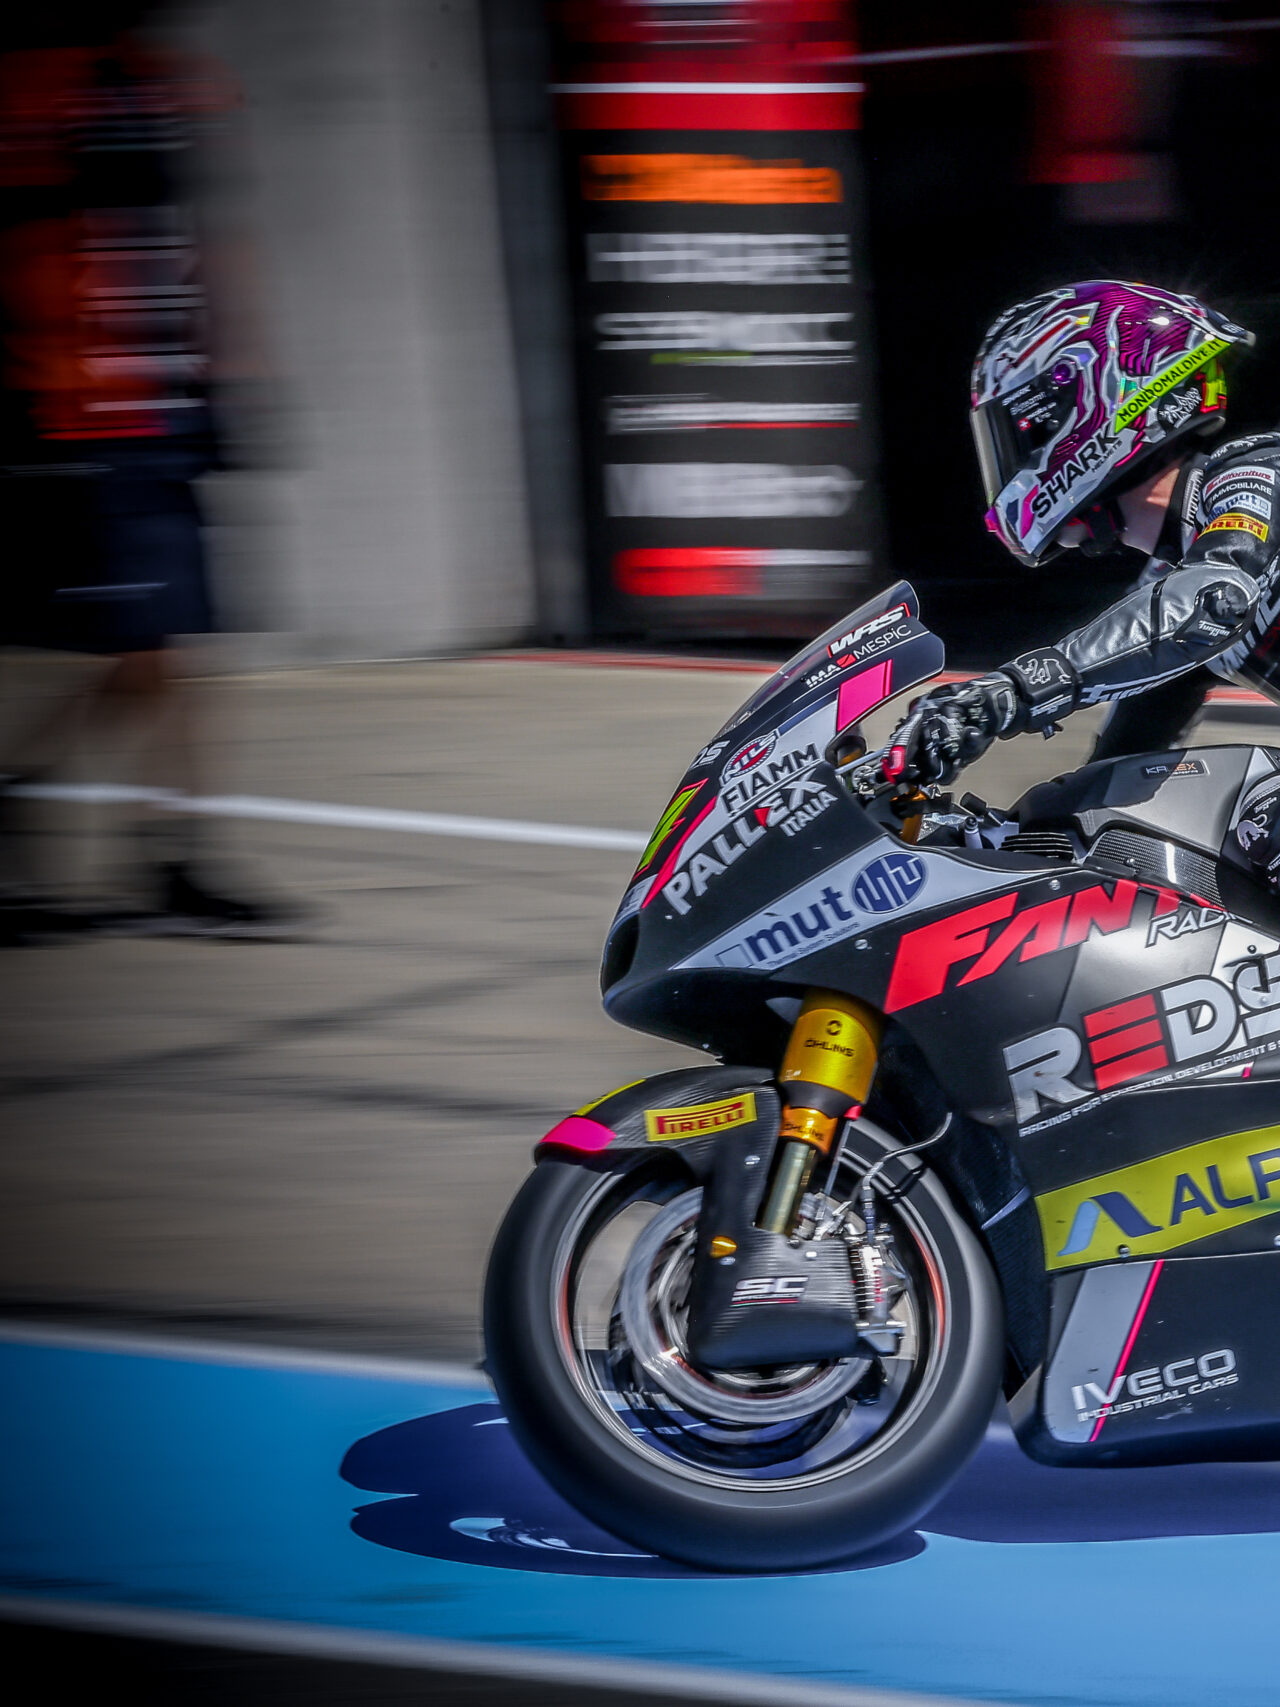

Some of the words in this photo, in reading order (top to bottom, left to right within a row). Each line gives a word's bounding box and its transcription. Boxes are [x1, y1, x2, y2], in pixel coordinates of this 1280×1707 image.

[1032, 421, 1119, 518] SHARK
[1212, 481, 1273, 501] IMMOBILIARE
[829, 605, 905, 655] WRS
[805, 664, 841, 688] IMA
[721, 742, 820, 815] FIAMM
[723, 731, 777, 783] NILS
[779, 790, 839, 837] ITALIA
[662, 767, 828, 916] PALLEX
[744, 886, 855, 963] mut
[1019, 1111, 1072, 1137] RACING
[1072, 1097, 1101, 1117] FOR
[1175, 1044, 1267, 1081] DEVELOPMENT
[656, 1101, 745, 1135] PIRELLI
[734, 1276, 809, 1297] SC
[1071, 1348, 1237, 1411] IVECO
[1077, 1389, 1187, 1423] INDUSTRIAL
[1187, 1373, 1239, 1395] CARS
